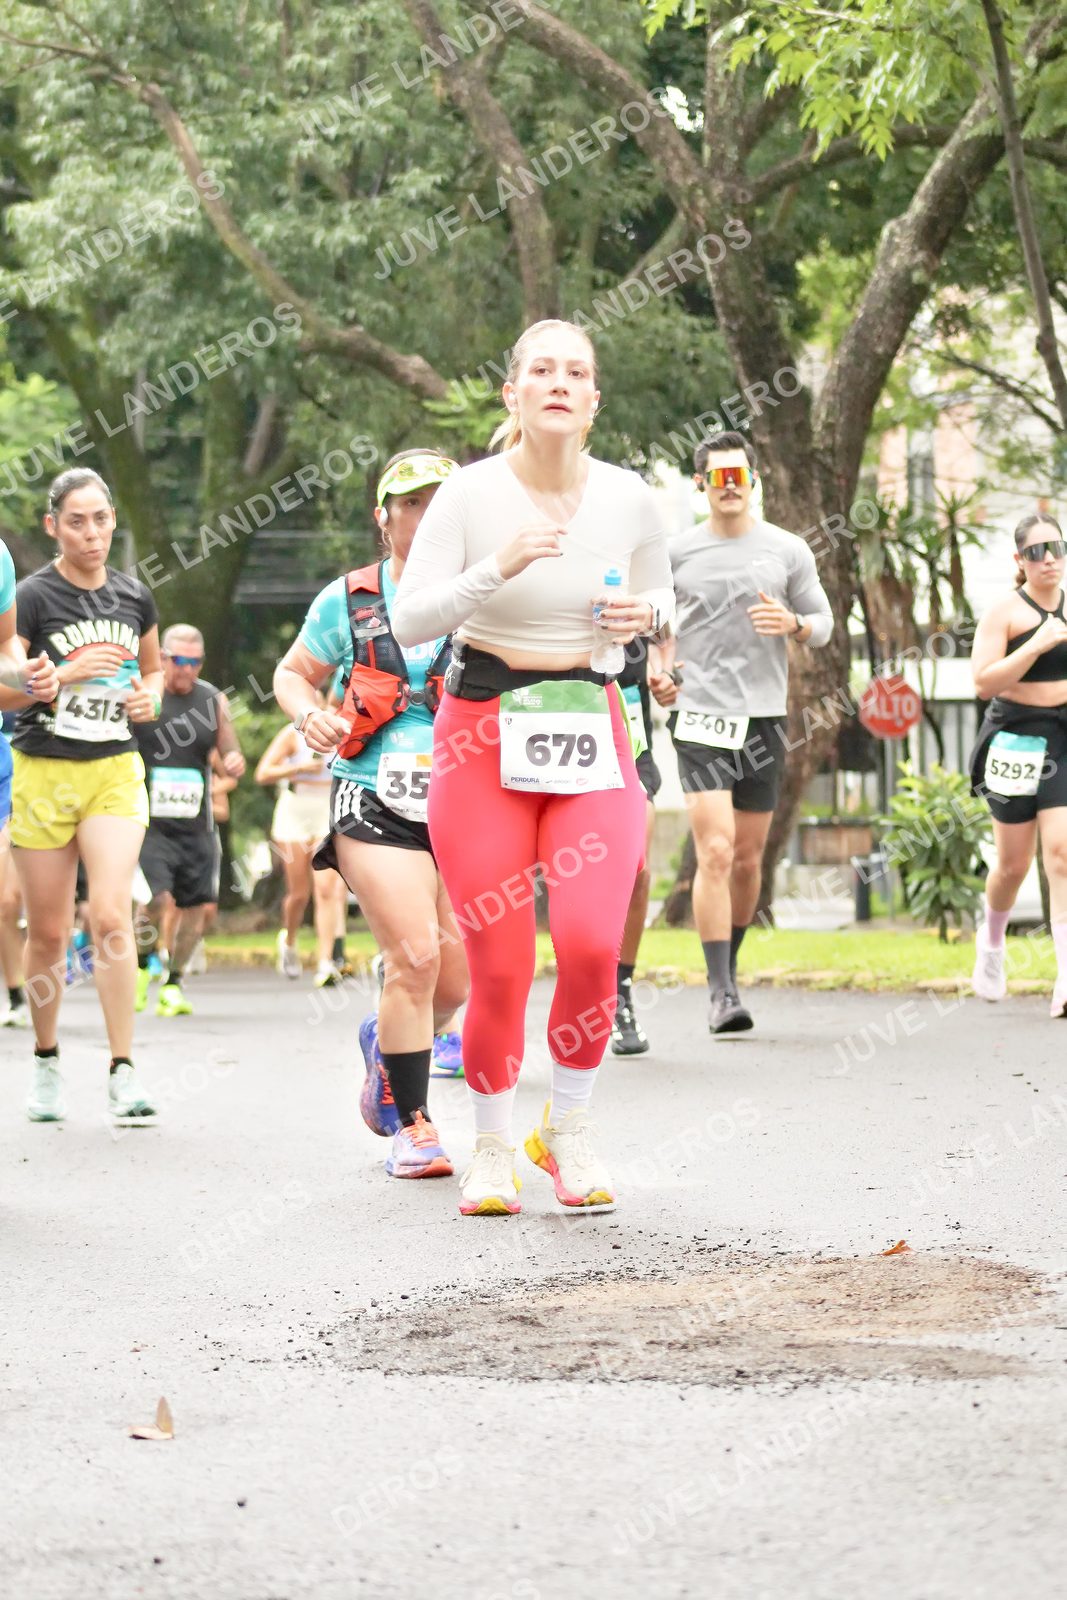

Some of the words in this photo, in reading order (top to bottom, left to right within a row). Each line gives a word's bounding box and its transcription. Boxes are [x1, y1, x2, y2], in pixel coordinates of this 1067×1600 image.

[65, 695, 125, 723] 4313
[525, 733, 598, 768] 679
[510, 776, 540, 784] PERDURA
[990, 758, 1037, 780] 5292
